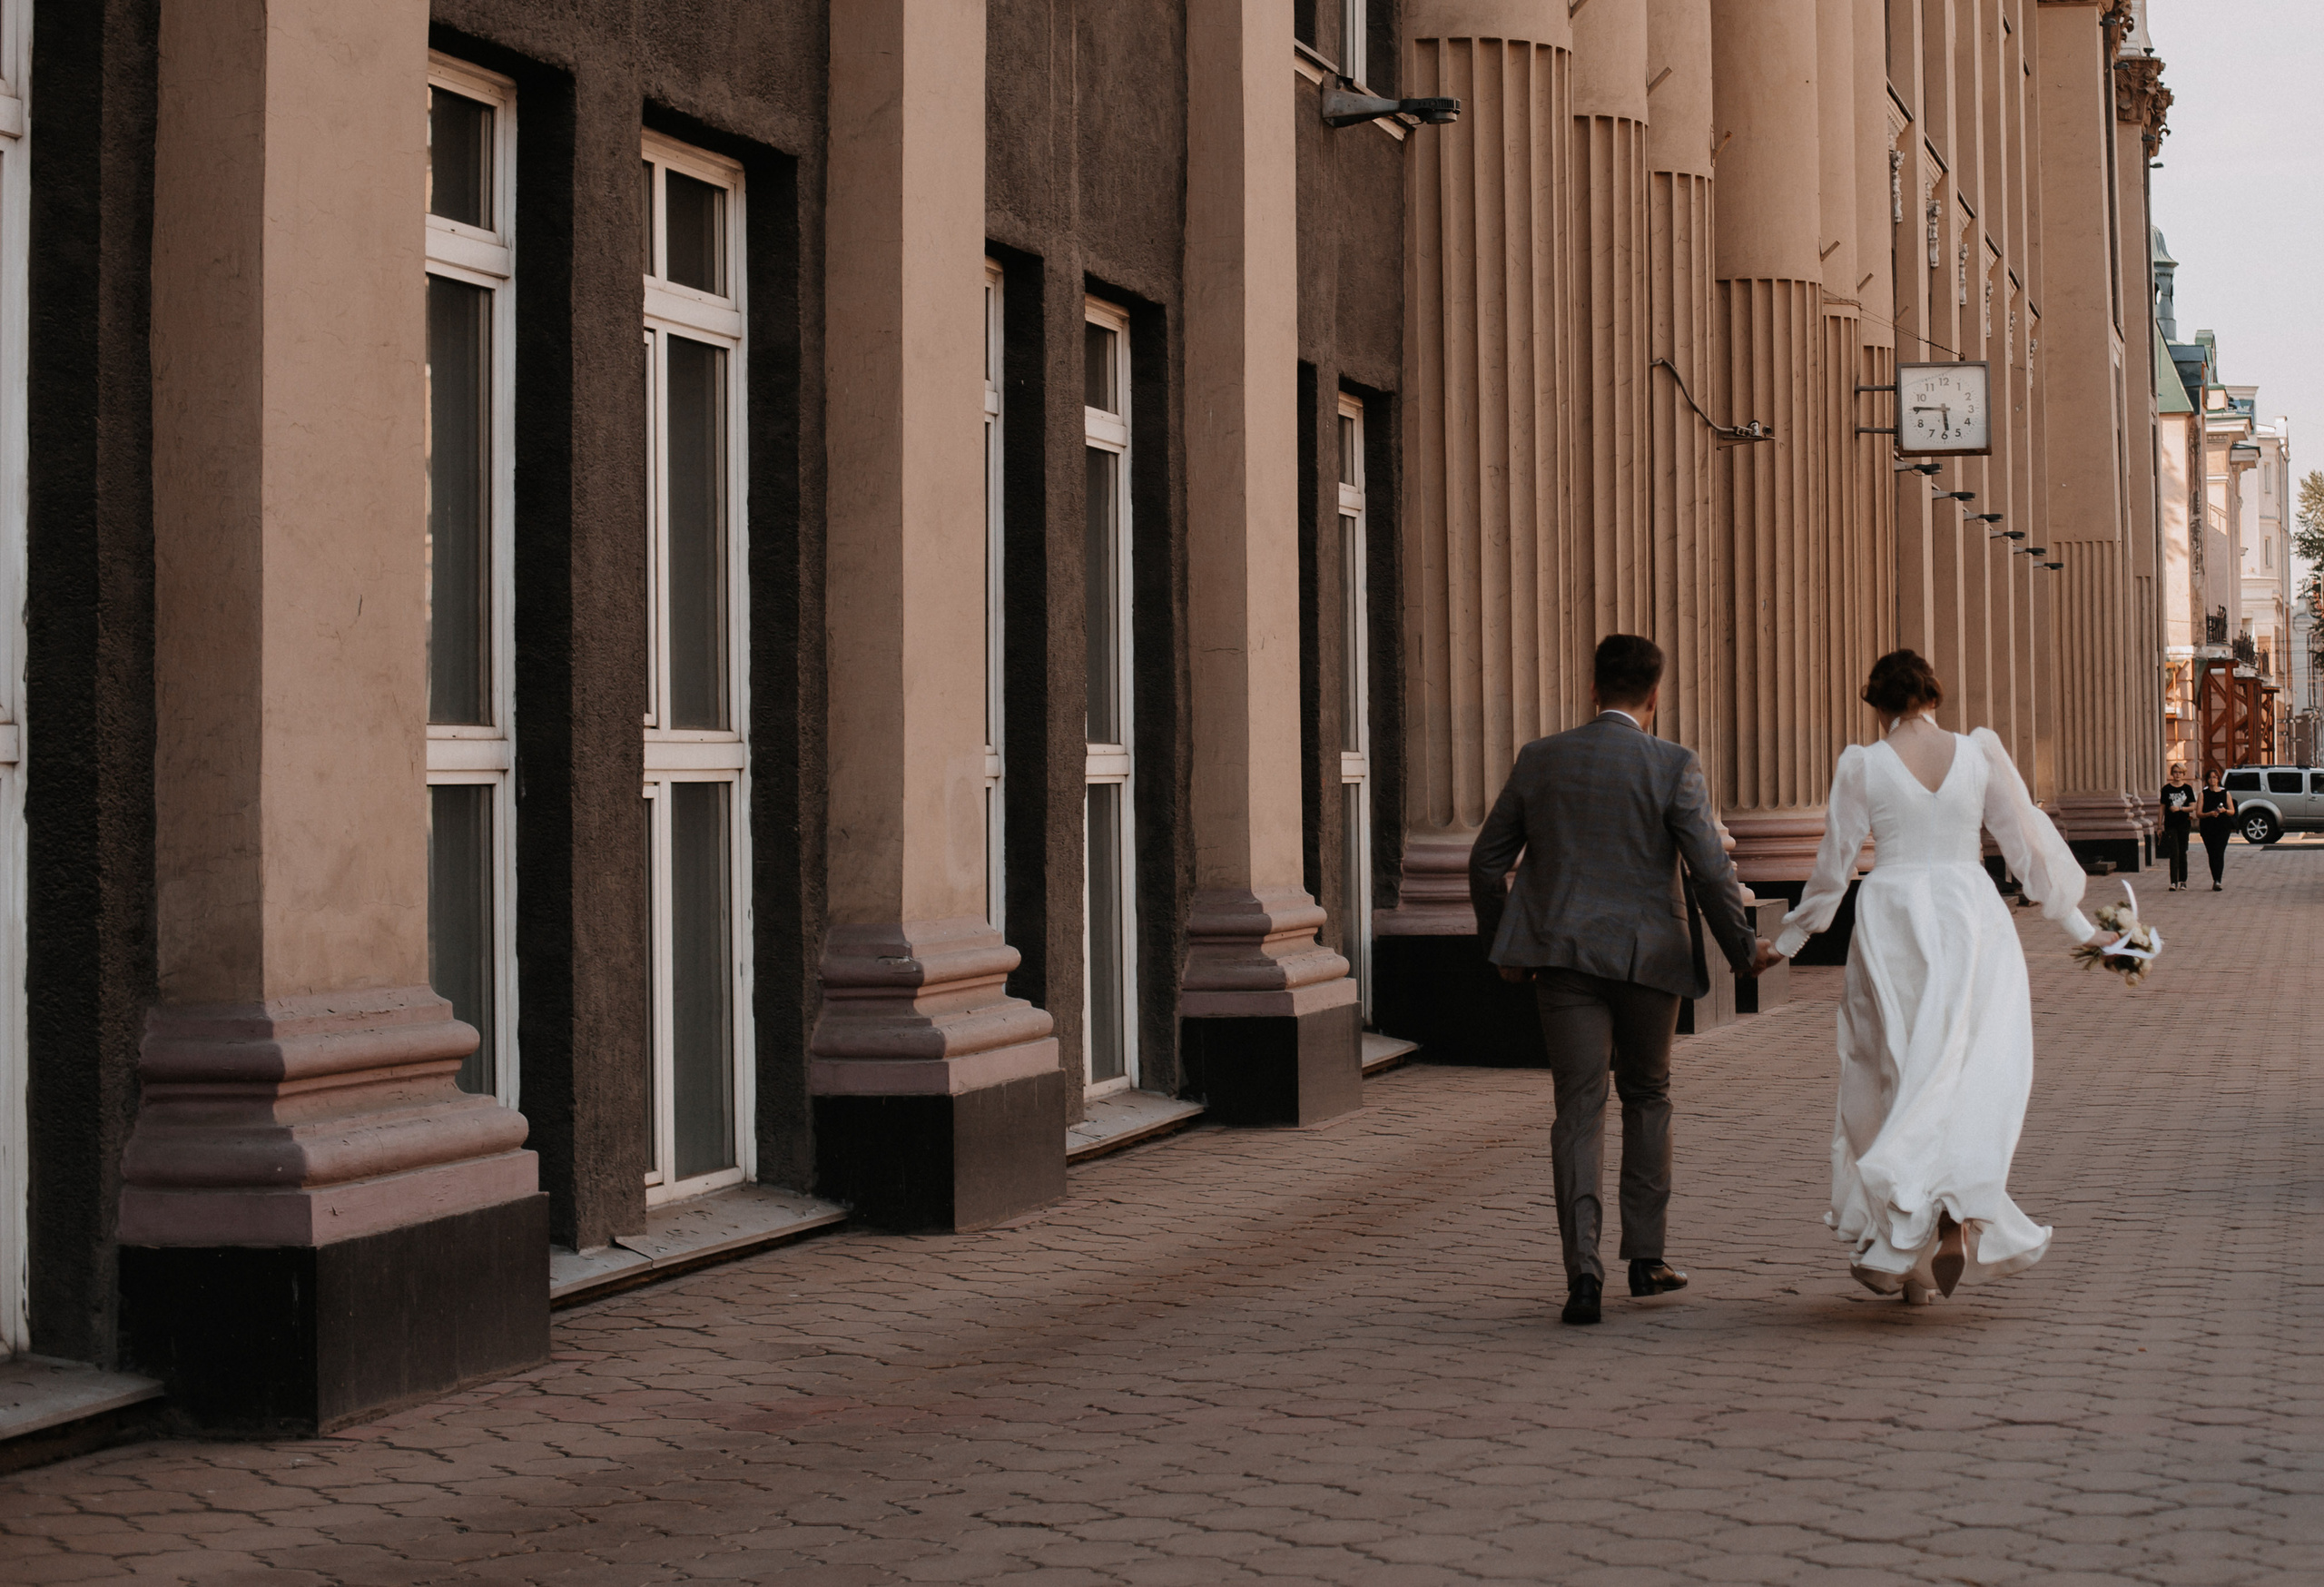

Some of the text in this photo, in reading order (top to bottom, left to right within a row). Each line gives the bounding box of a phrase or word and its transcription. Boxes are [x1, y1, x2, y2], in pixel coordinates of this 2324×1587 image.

[1938, 377, 1949, 386] 12
[1956, 382, 1961, 390] 1
[1925, 382, 1935, 391] 11
[1916, 393, 1926, 402] 10
[1965, 392, 1972, 400] 2
[1968, 404, 1974, 413] 3
[1917, 419, 1924, 428] 8
[1964, 418, 1971, 426] 4
[1928, 429, 1935, 438] 7
[1941, 430, 1948, 439] 6
[1955, 429, 1961, 437] 5
